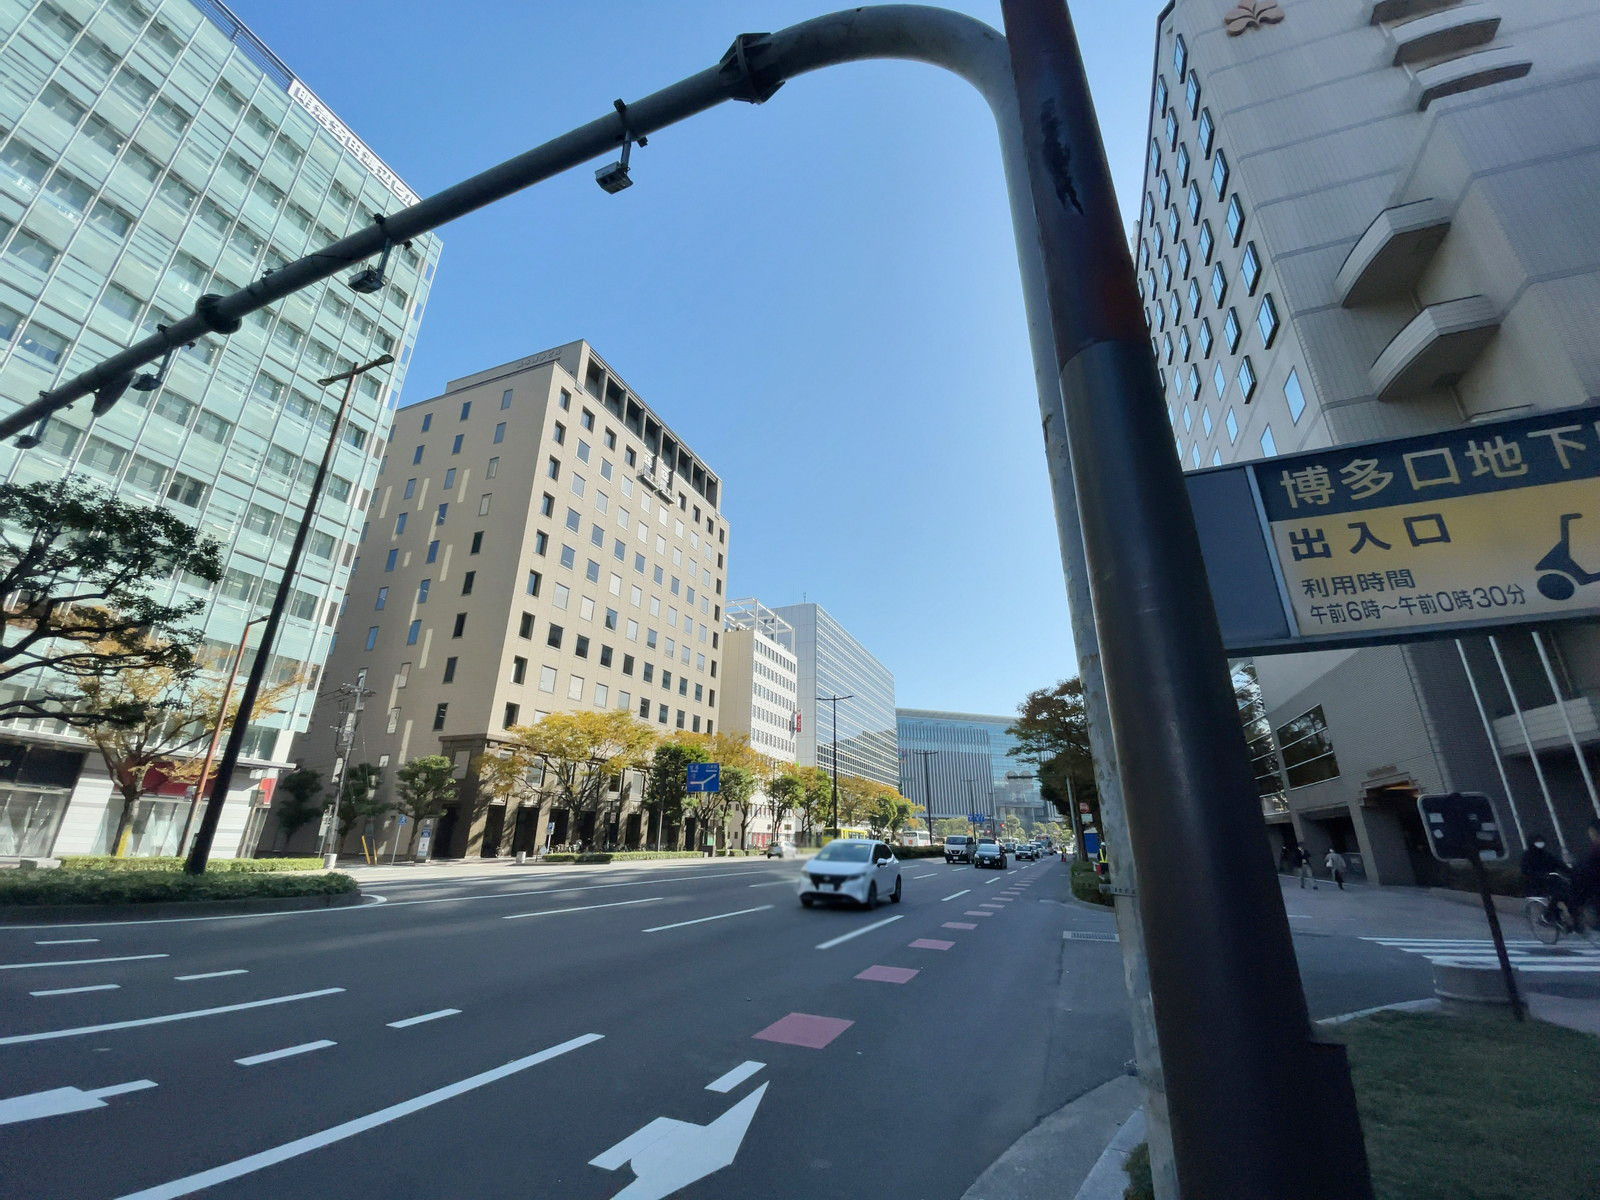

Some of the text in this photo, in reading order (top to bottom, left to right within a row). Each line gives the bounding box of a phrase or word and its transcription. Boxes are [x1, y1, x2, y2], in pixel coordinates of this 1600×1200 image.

[1280, 420, 1600, 508] 博多口地下
[1289, 513, 1452, 562] 出入口
[1302, 568, 1416, 598] 利用時間
